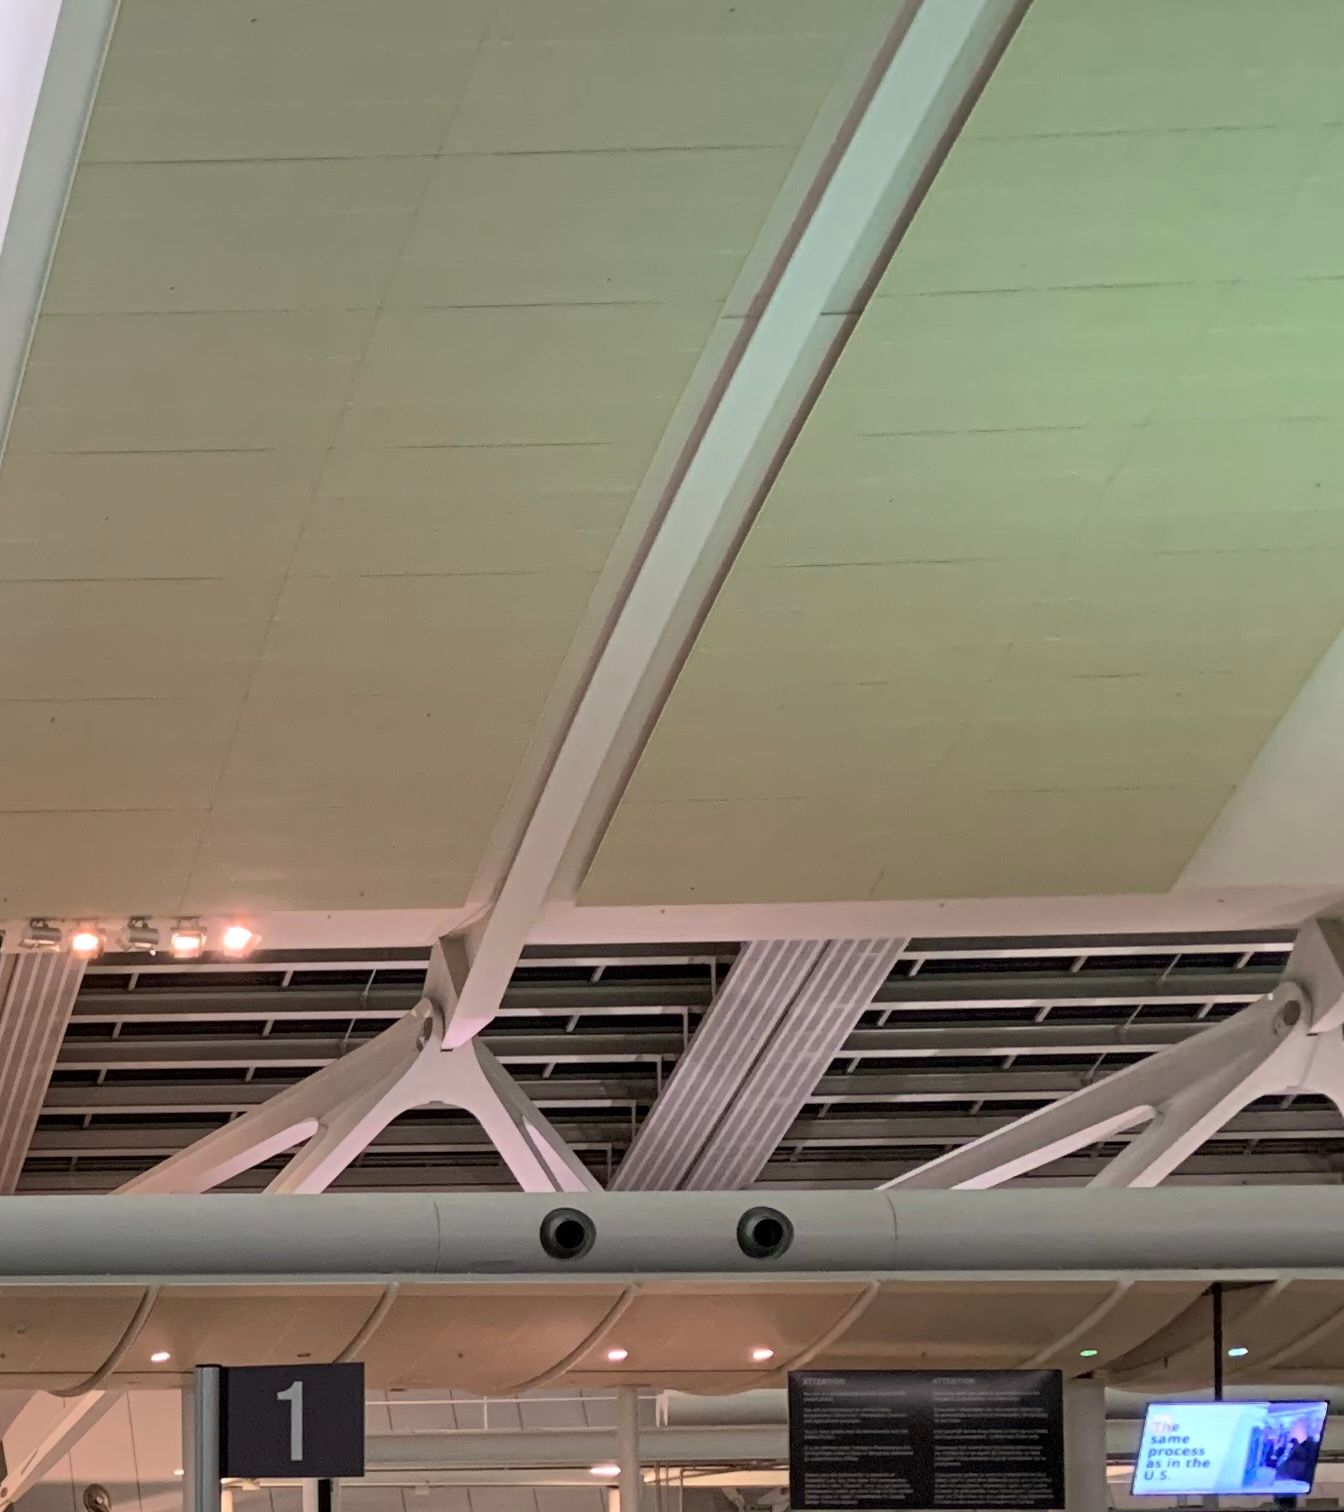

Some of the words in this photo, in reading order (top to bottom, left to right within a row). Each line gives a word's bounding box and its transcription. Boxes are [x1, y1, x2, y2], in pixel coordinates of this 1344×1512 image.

[276, 1380, 304, 1461] 1
[1154, 1421, 1179, 1432] The
[1151, 1435, 1190, 1444] same
[1148, 1446, 1205, 1458] process
[1146, 1460, 1162, 1469] as
[1166, 1458, 1181, 1468] in
[1185, 1458, 1211, 1468] the
